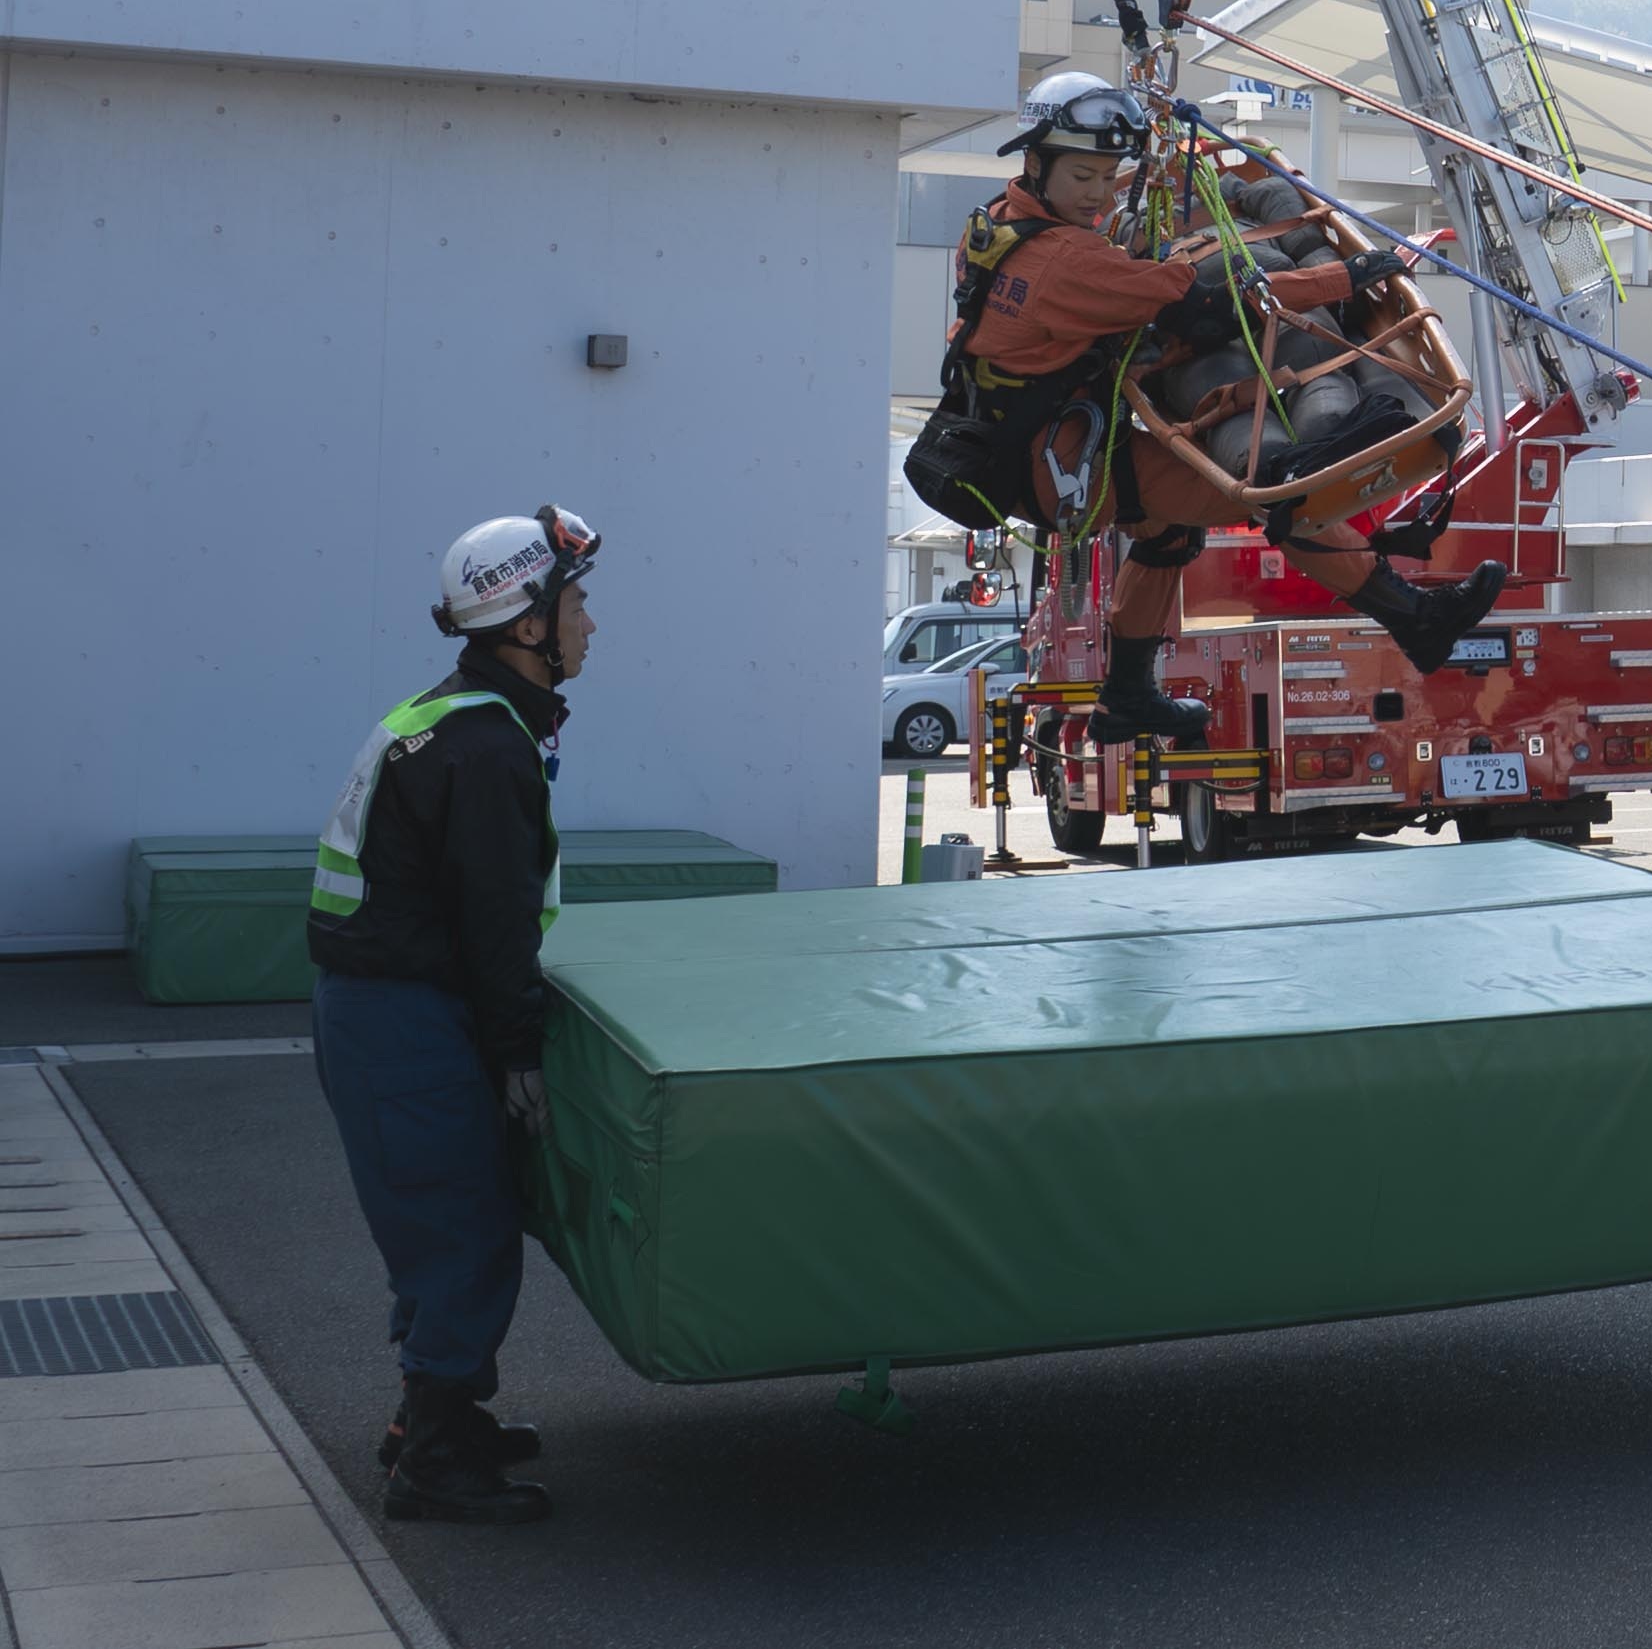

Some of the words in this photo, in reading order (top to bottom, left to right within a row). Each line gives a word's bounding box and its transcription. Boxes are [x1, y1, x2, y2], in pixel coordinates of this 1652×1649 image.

[471, 539, 549, 595] 倉敷市消防局
[1287, 689, 1351, 703] No.26.02-306
